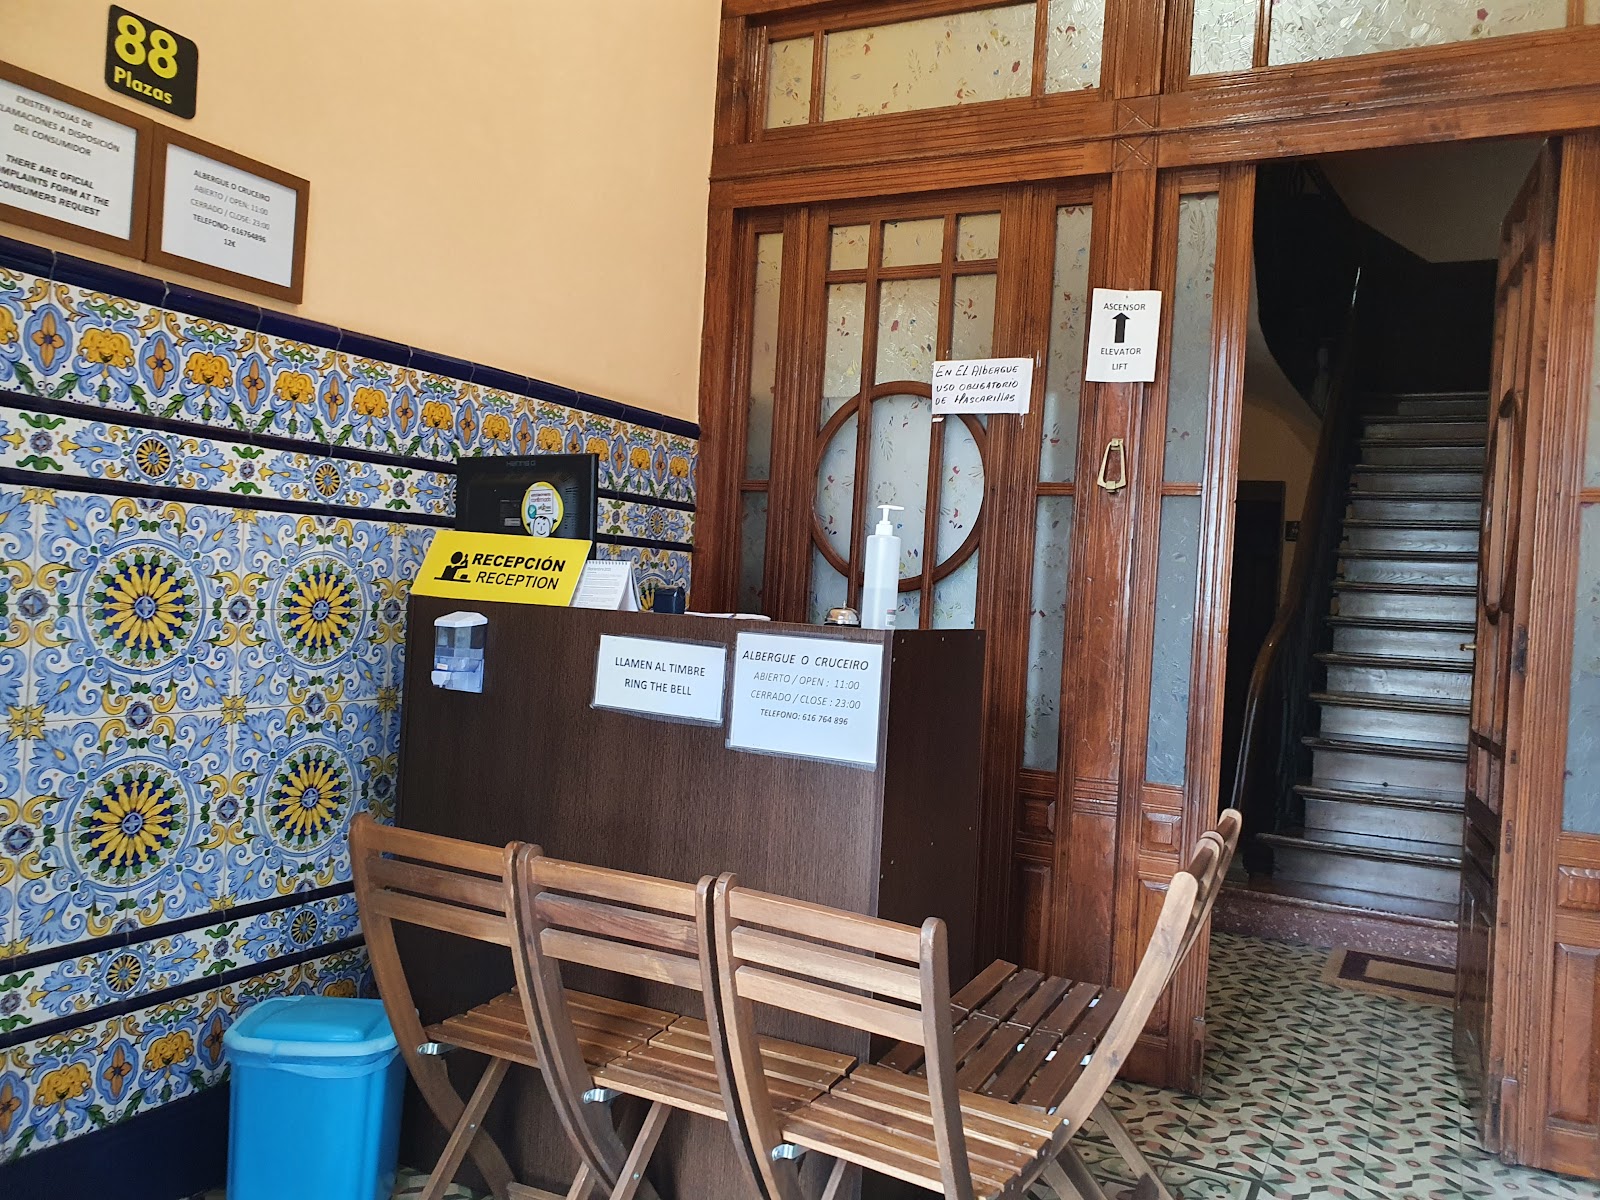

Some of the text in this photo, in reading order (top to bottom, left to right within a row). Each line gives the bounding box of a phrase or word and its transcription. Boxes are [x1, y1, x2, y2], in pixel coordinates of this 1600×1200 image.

[114, 14, 178, 79] 88
[113, 65, 173, 105] Plazas
[16, 95, 94, 129] EXISTEN HOJAS DE
[0, 102, 120, 153] LAMACIONES A DISPOSICIÓN
[13, 123, 92, 157] DEL CONSUMIDOR
[6, 153, 95, 190] THERE ARE OFICIAL
[0, 164, 110, 208] MPLAINTS FORM AT THE
[193, 169, 230, 189] ALBERGUE
[237, 185, 271, 203] CRUCEIRO
[58, 198, 101, 217] REQUEST
[193, 184, 224, 201] ABIERTO
[251, 204, 269, 216] 11:00
[190, 198, 223, 215] CERRADO
[252, 218, 271, 231] 23:00
[192, 213, 231, 232] TELEFONO:
[223, 238, 237, 248] 12€
[1103, 302, 1147, 312] ASCENSOR
[1100, 347, 1142, 356] ELEVATOR
[1111, 362, 1129, 371] LIFT
[936, 383, 956, 393] USO
[935, 396, 948, 406] DE
[471, 552, 566, 573] RECEPCIÓN
[475, 571, 560, 590] RECEPTION
[615, 656, 706, 678] LLAMEN AL TIMBRE
[742, 650, 869, 671] ALBERGUE O CRUCEIRO
[624, 678, 692, 696] RING THE BELL
[753, 671, 791, 683] ABIERTO
[799, 676, 825, 687] OPEN
[834, 680, 860, 690] 11:00
[750, 689, 792, 702] CERRADO
[799, 695, 828, 706] CLOSE
[834, 698, 861, 710] 23:00
[760, 708, 849, 726] TELEFONO: 616 764 896
